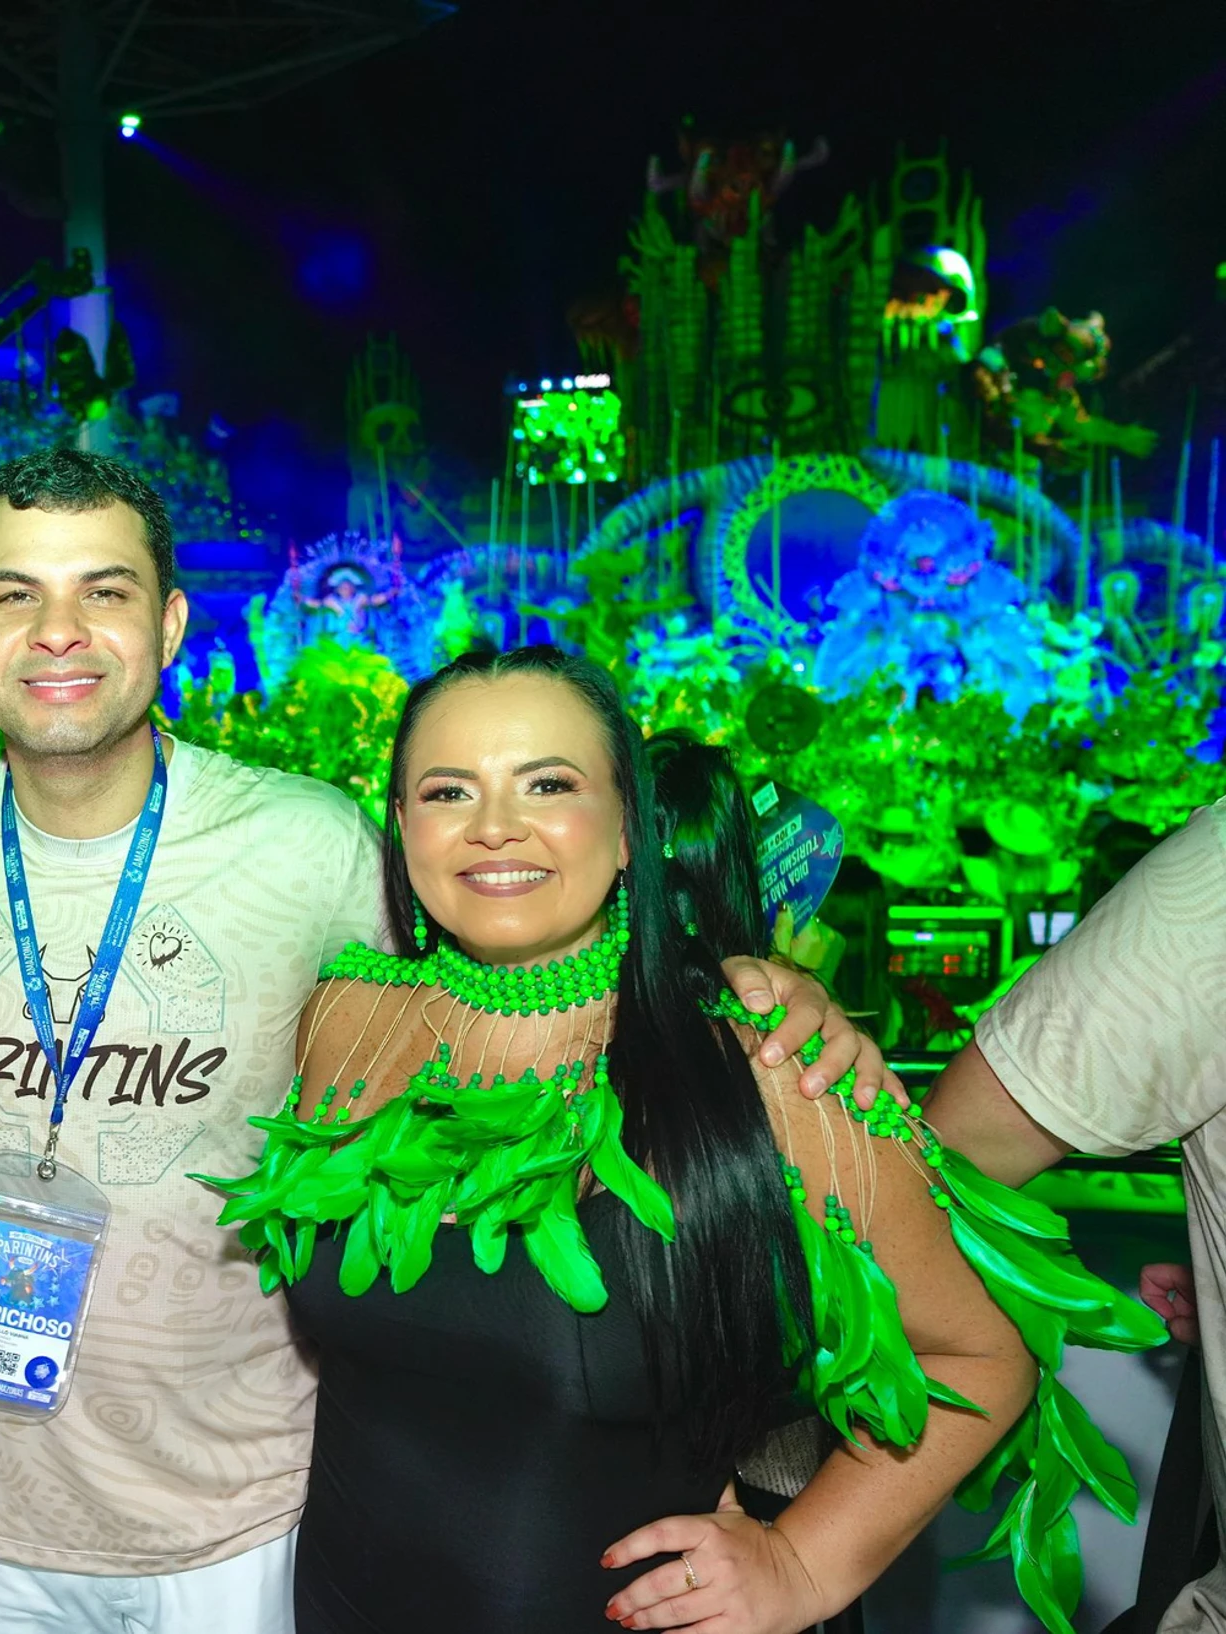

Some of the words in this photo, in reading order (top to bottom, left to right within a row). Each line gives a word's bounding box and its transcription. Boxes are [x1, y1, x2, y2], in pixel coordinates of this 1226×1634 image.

[132, 827, 153, 868] AMAZONAS
[779, 834, 819, 875] TURISMO
[788, 860, 809, 887] DIGA
[20, 936, 37, 977] AMAZONAS
